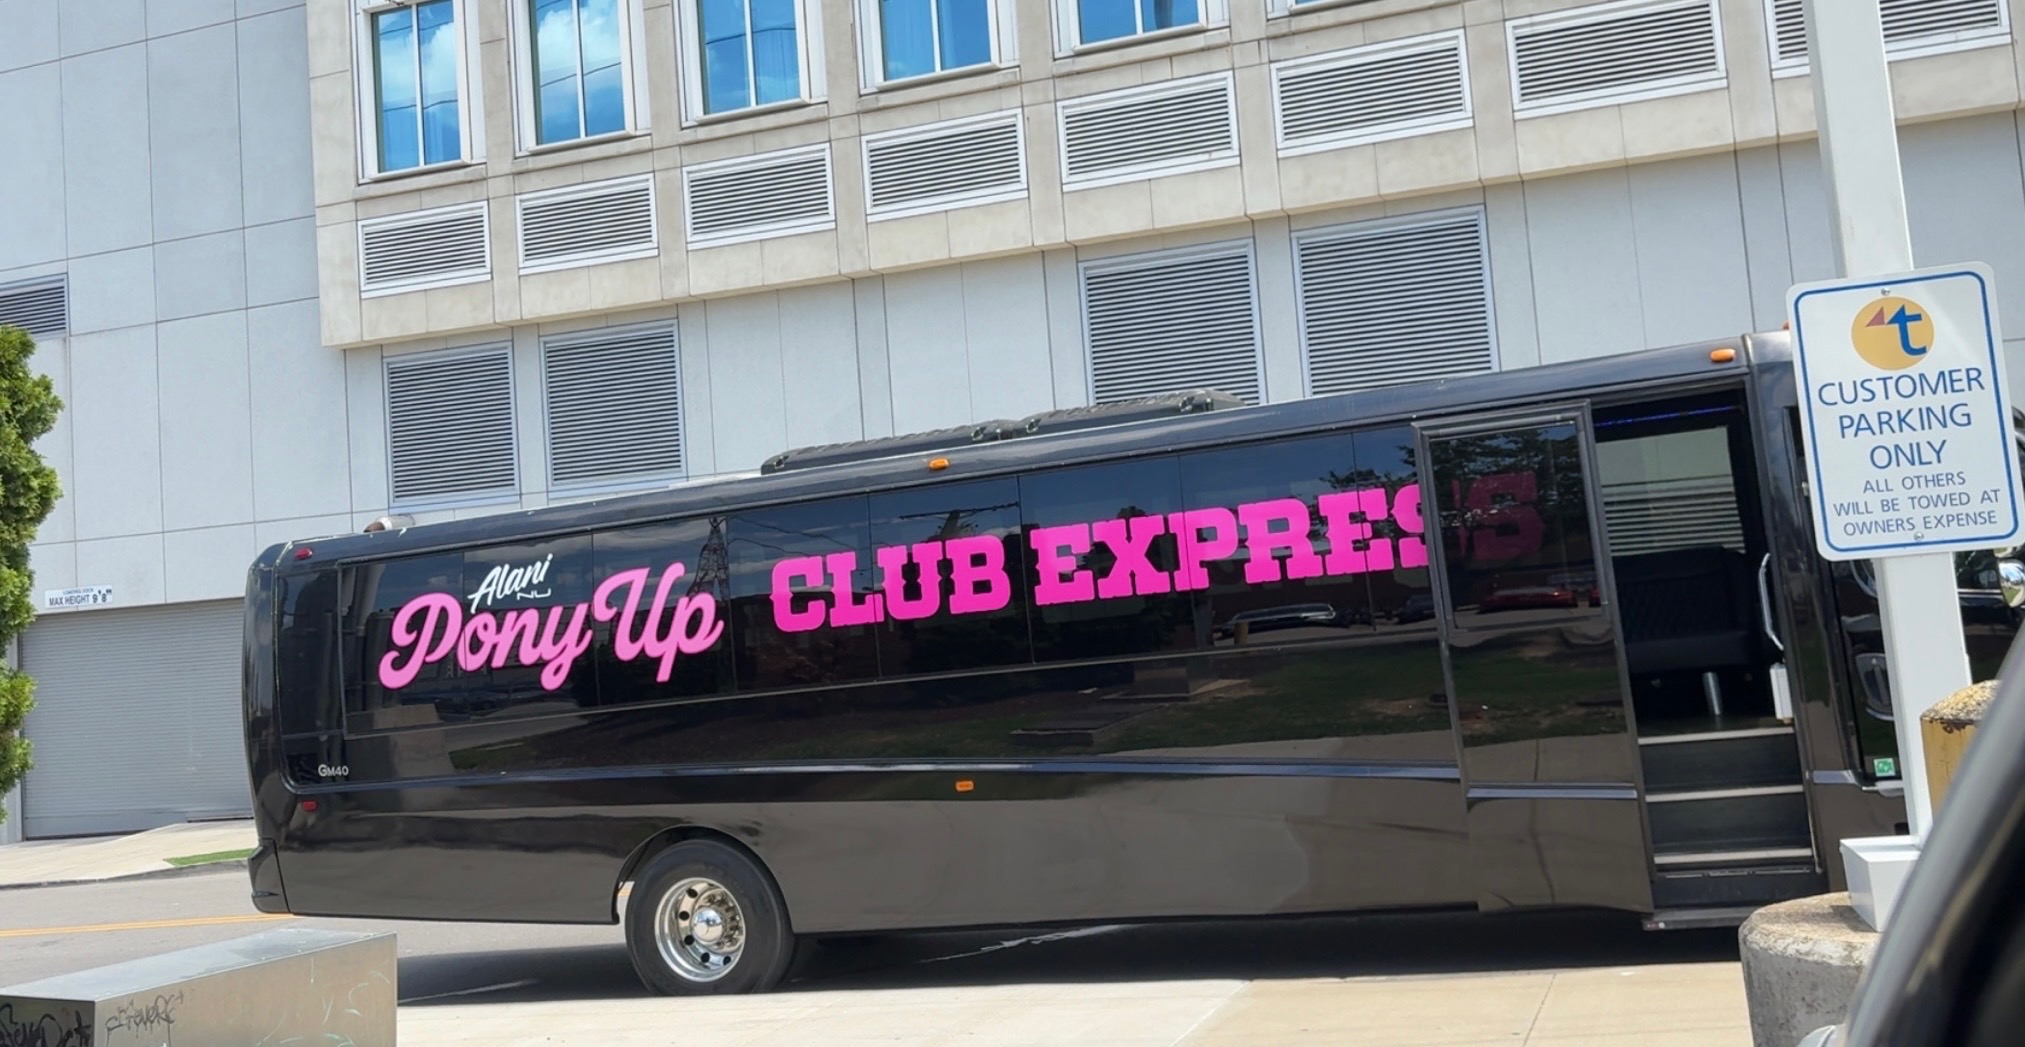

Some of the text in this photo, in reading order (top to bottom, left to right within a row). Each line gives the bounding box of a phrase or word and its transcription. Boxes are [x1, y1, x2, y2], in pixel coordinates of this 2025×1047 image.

[1818, 367, 1985, 406] CUSTOMER
[1839, 403, 1973, 439] PARKING
[1869, 439, 1947, 470] ONLY
[1863, 471, 1967, 494] ALL OTHERS
[1833, 489, 2001, 517] WILL BE TOWED AT
[1843, 510, 1997, 537] OWNERS EXPENSE
[467, 553, 553, 614] Alani
[517, 588, 551, 600] NU
[771, 533, 1012, 634] CLUB
[49, 597, 64, 606] MAX
[64, 594, 90, 605] HEIGHT
[378, 561, 725, 692] Pony Up
